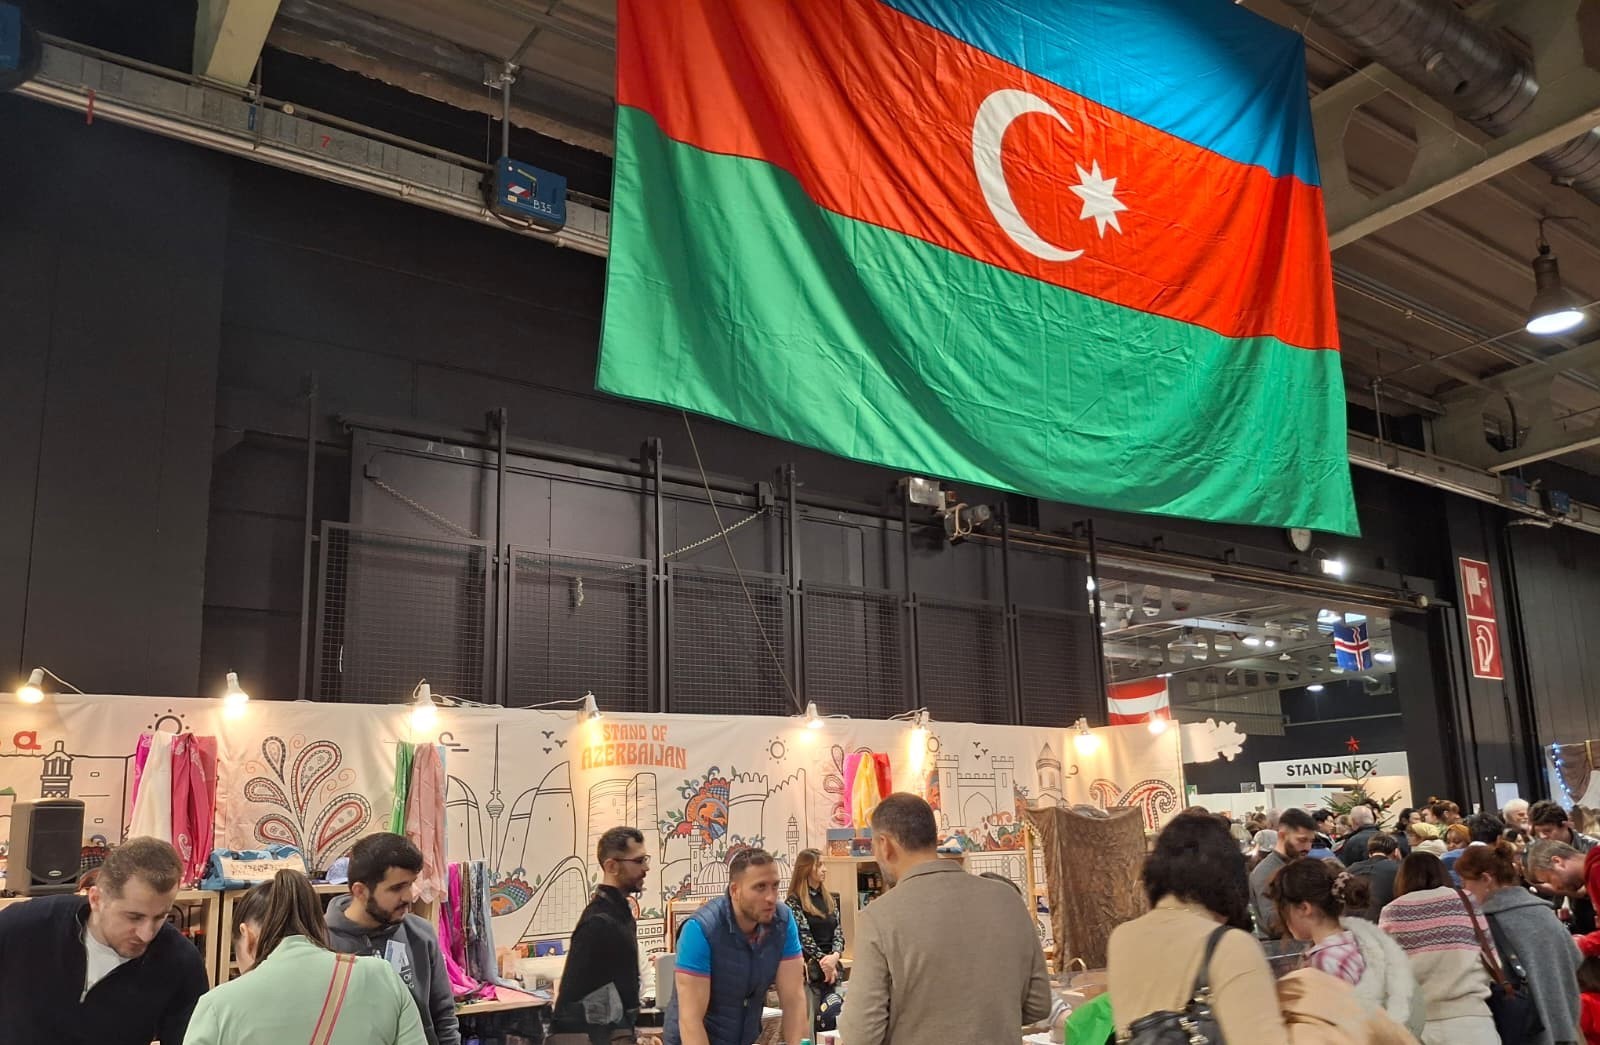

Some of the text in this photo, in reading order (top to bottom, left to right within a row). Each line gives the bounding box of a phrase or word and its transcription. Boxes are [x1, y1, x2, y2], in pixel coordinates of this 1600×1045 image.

[603, 724, 668, 741] STAND OF
[581, 742, 687, 770] AZERBAIJAN
[1286, 759, 1373, 777] STAND INFO
